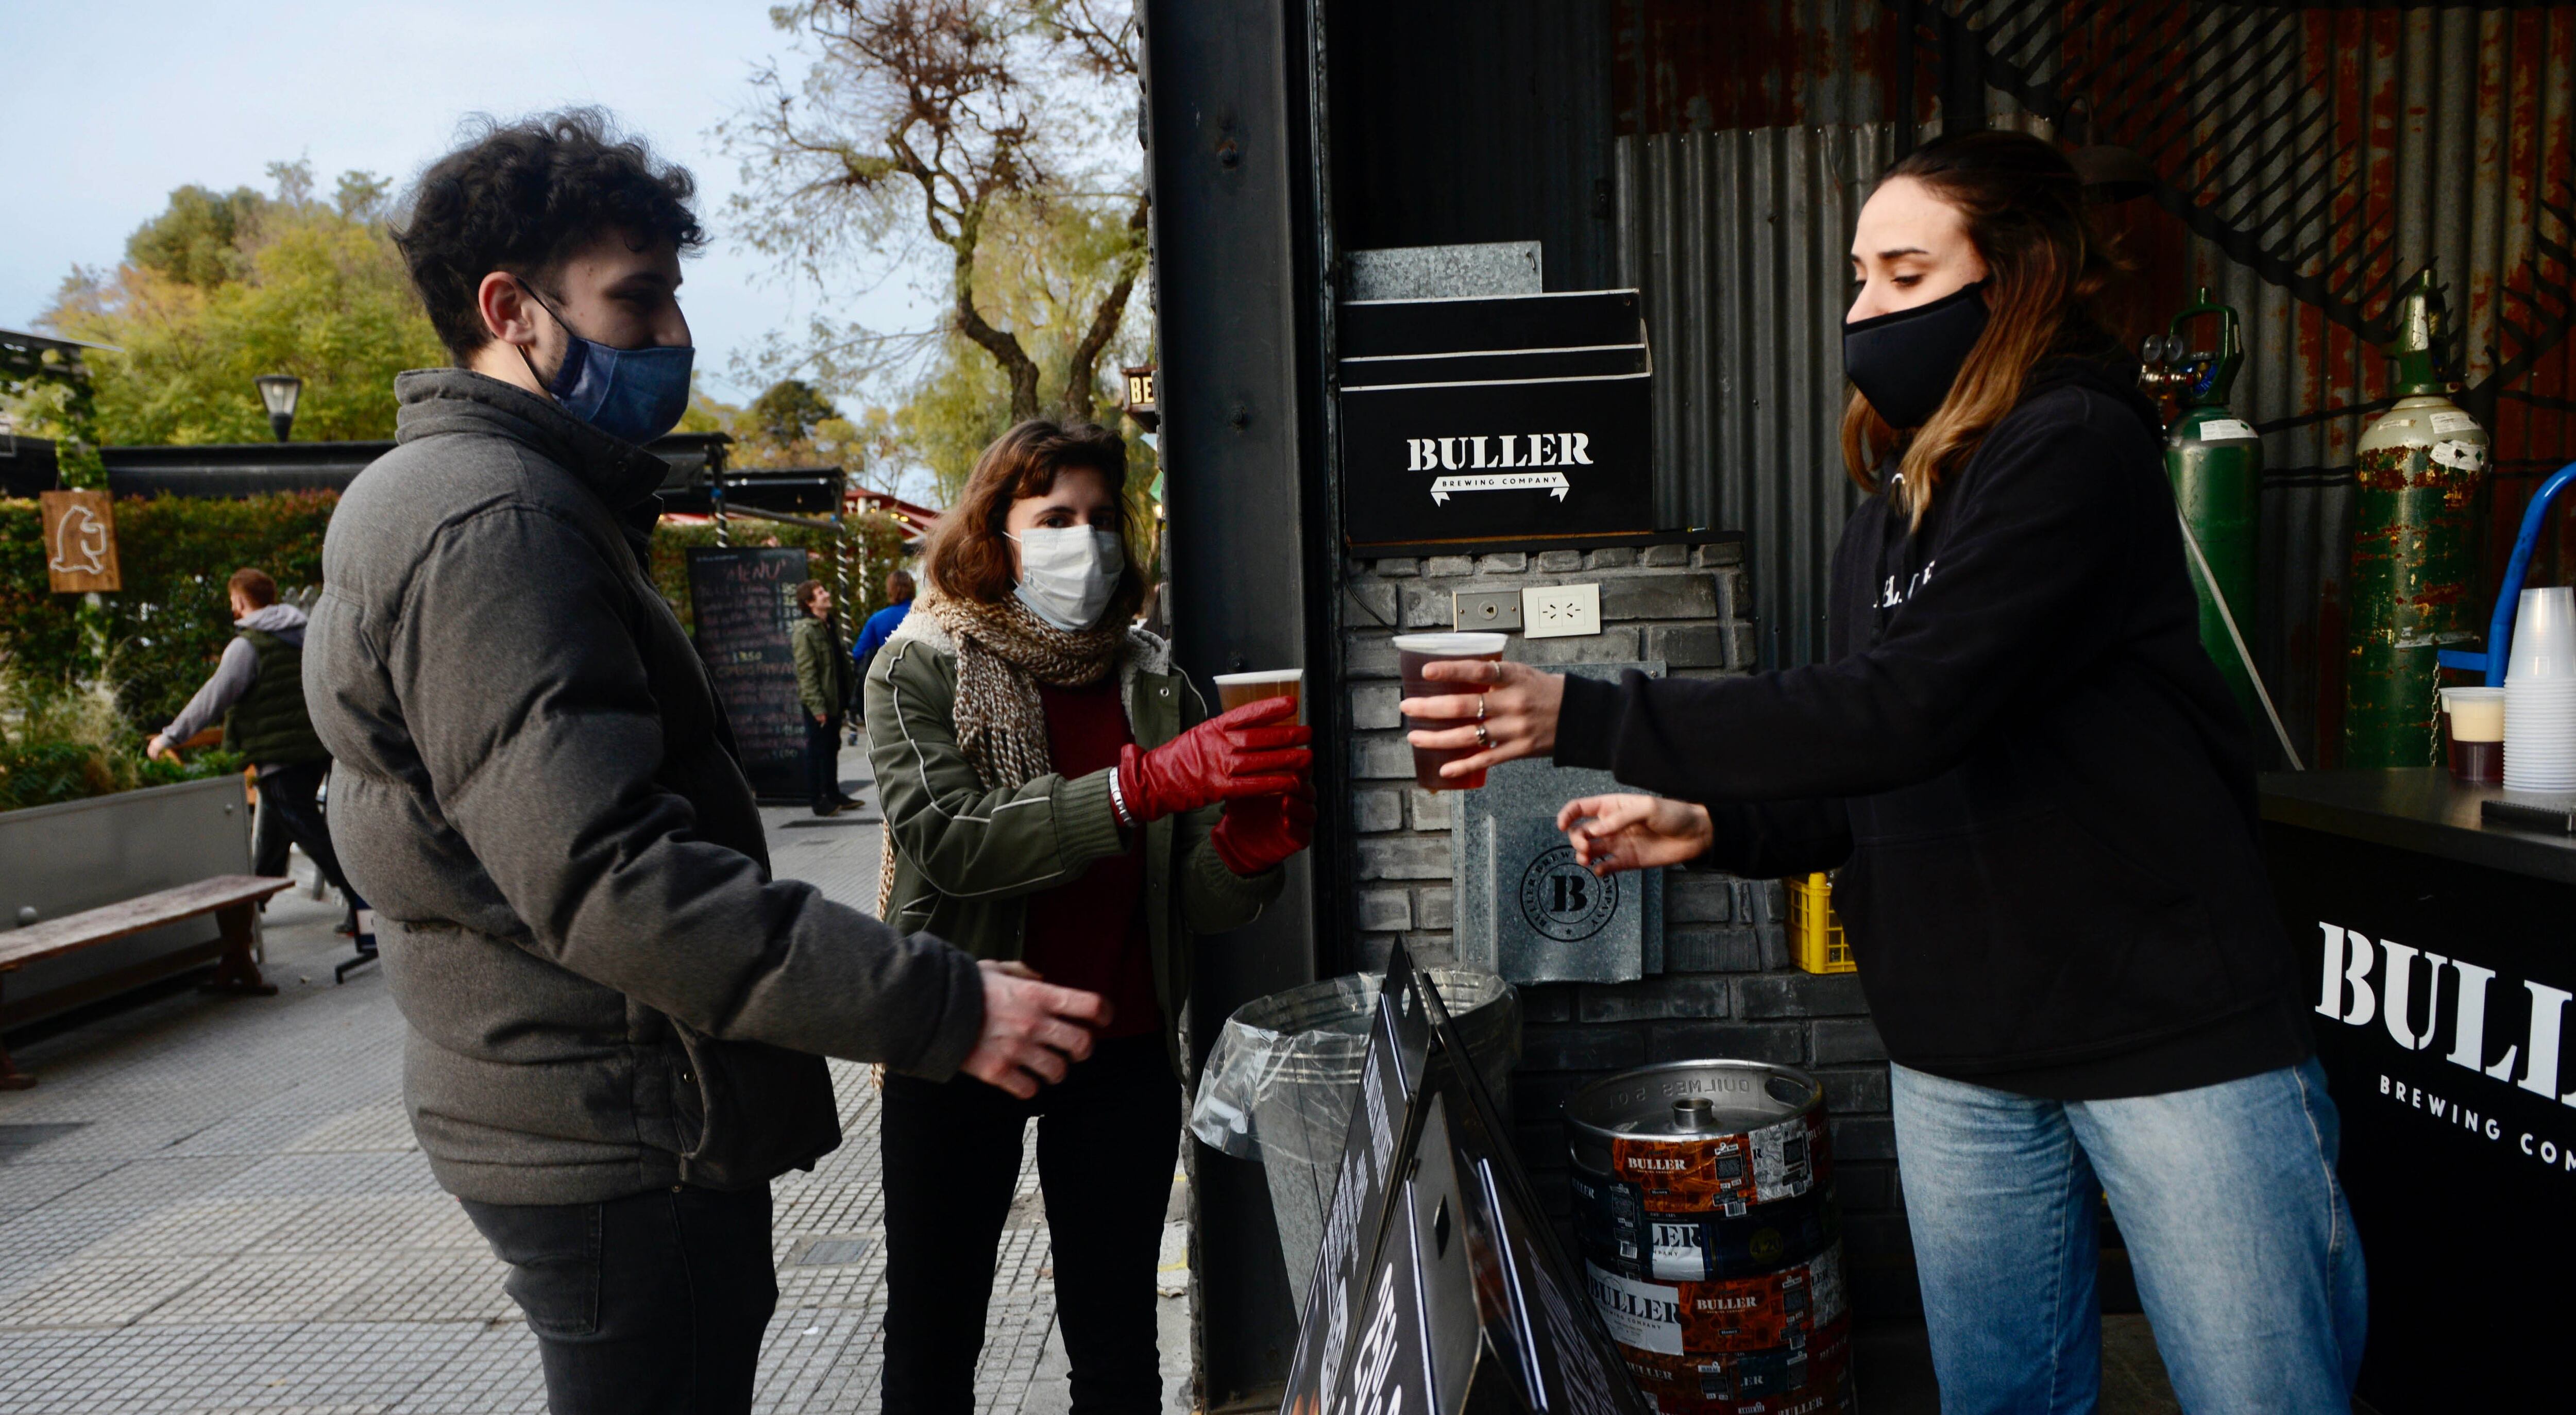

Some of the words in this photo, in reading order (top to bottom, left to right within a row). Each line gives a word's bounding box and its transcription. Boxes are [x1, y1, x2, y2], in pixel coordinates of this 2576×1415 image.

[1407, 433, 1594, 471] BULLER
[1443, 479, 1495, 487] BREWING
[1502, 477, 1557, 485] COMPANY
[1551, 875, 1588, 912] B
[1592, 874, 1613, 927] OMPANY
[2380, 1074, 2501, 1140] BREWING
[1372, 1093, 1393, 1195] BRISKET
[1628, 1157, 1687, 1170] BULLER
[1653, 1225, 1702, 1248] ER
[1697, 1296, 1757, 1310] BULLER
[1325, 1292, 1343, 1402] $549
